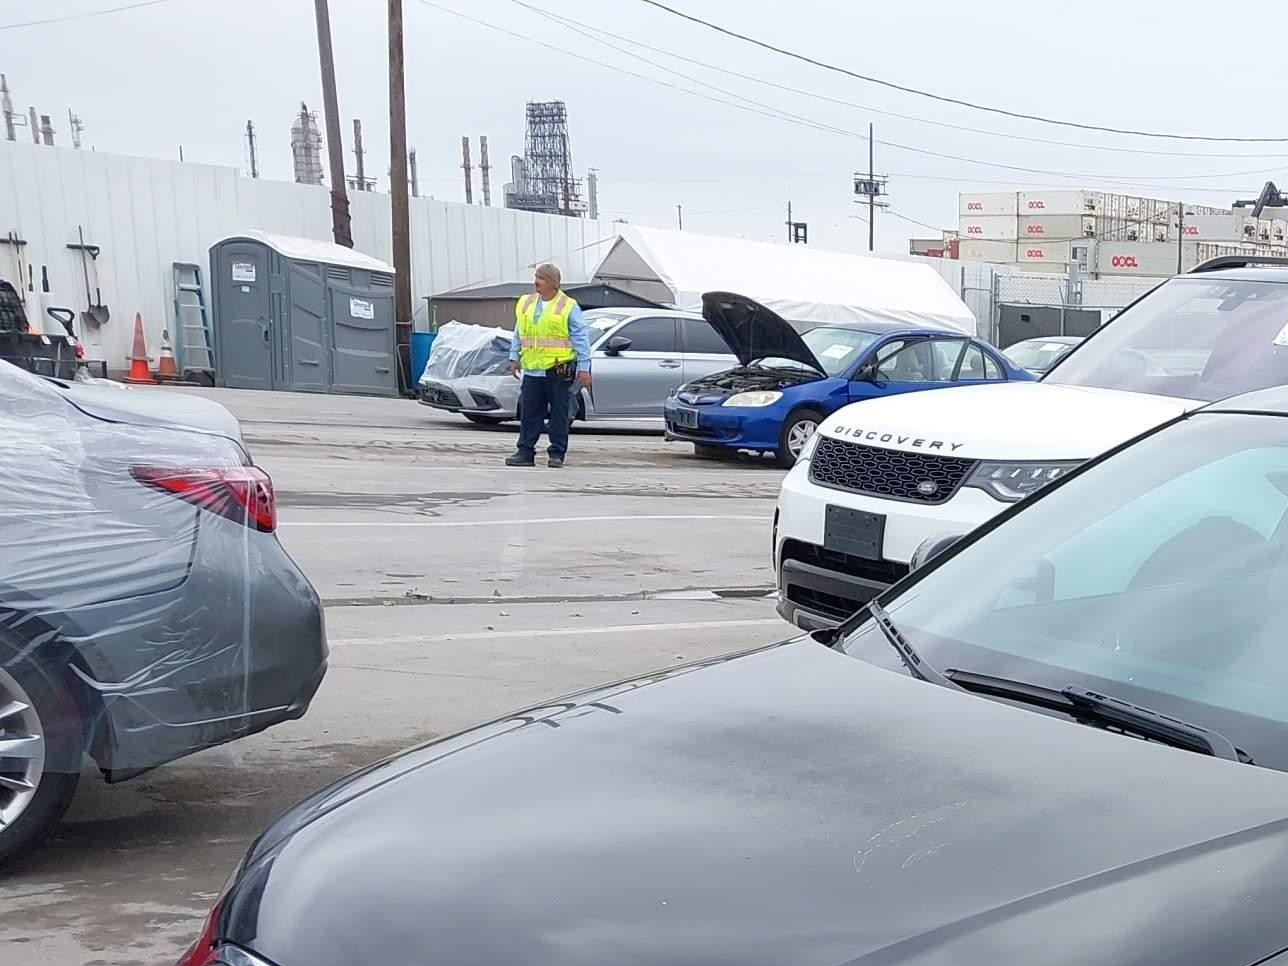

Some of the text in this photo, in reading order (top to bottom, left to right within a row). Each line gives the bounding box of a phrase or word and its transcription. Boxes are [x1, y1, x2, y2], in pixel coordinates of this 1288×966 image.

[967, 202, 983, 210] OOCL
[1028, 201, 1045, 209] OOCL
[967, 226, 983, 234] OOCL
[1027, 226, 1045, 234] OOCL
[1026, 250, 1044, 258] OOCL
[1111, 256, 1138, 268] OOCL
[834, 425, 965, 451] DISCOVERY
